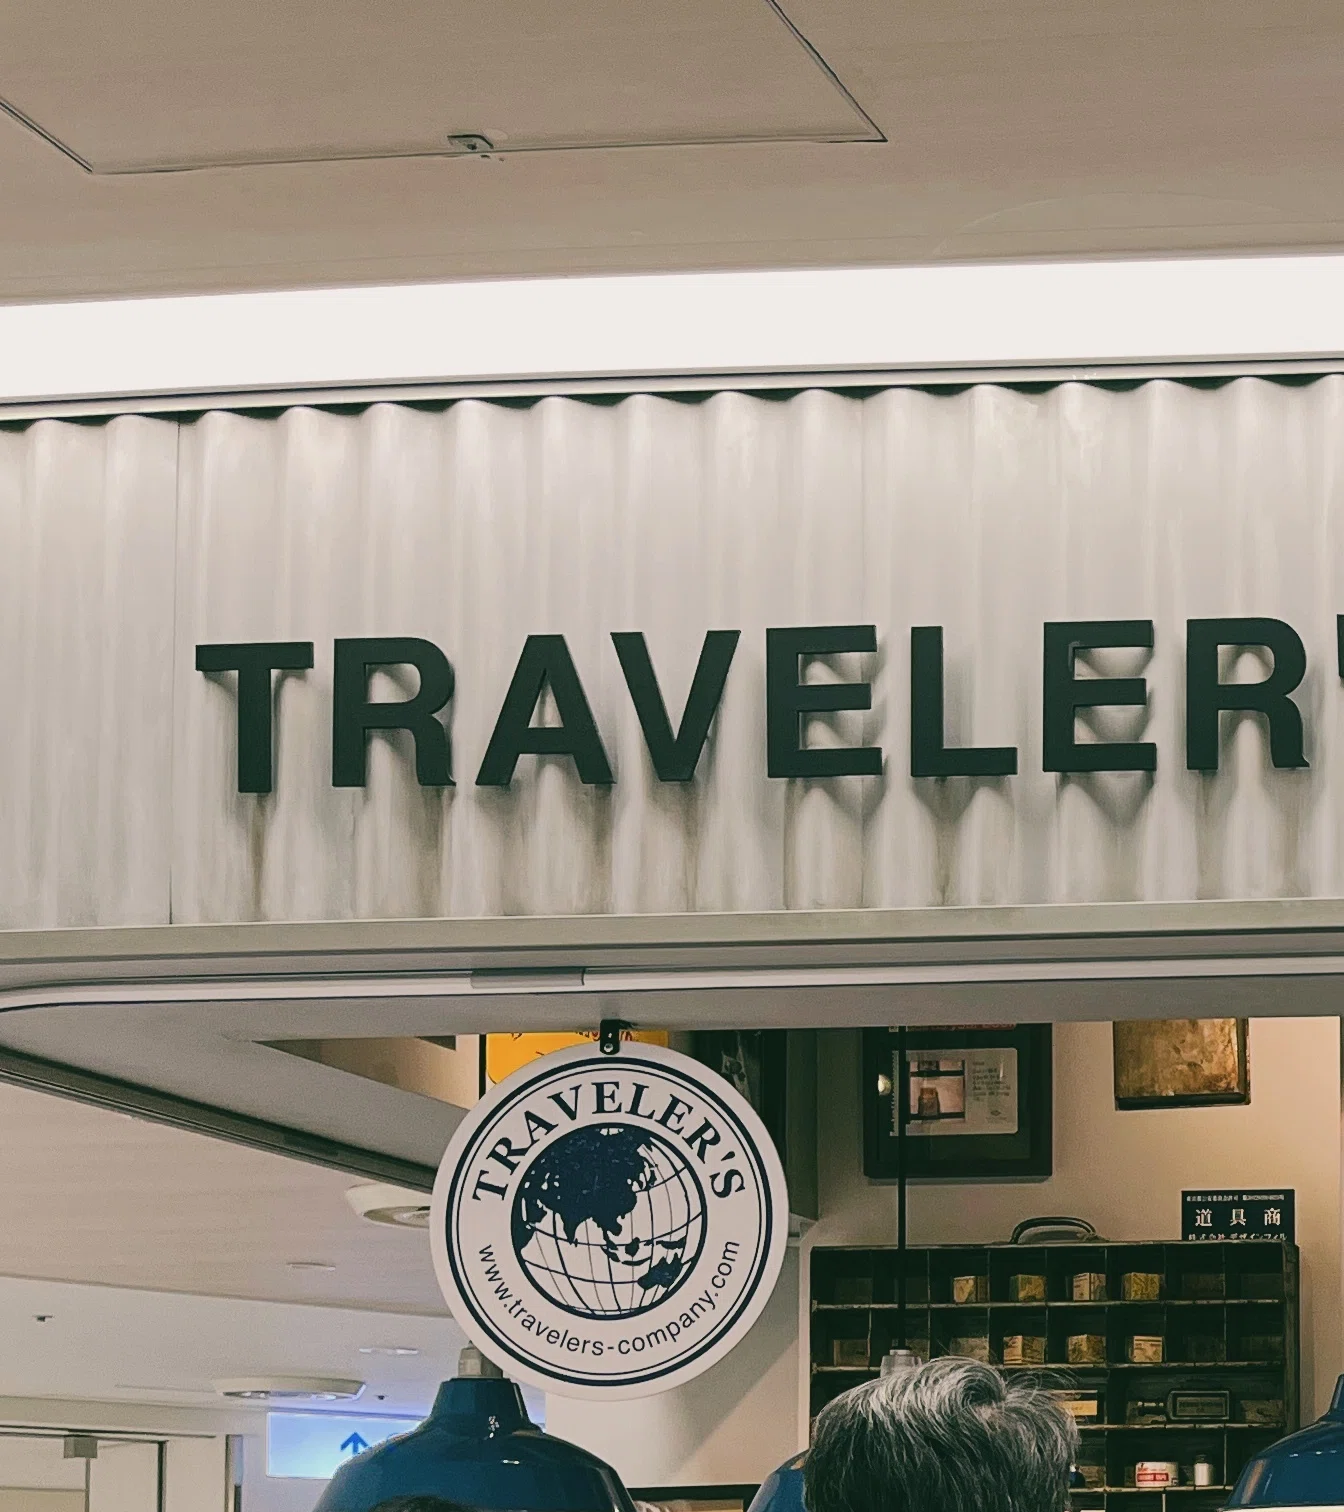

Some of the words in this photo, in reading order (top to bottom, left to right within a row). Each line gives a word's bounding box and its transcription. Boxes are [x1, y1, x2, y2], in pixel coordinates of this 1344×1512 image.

[473, 1081, 745, 1202] TRAVELER'S
[1195, 1208, 1281, 1227] 道具商
[479, 1240, 740, 1356] www.travelers-company.com
